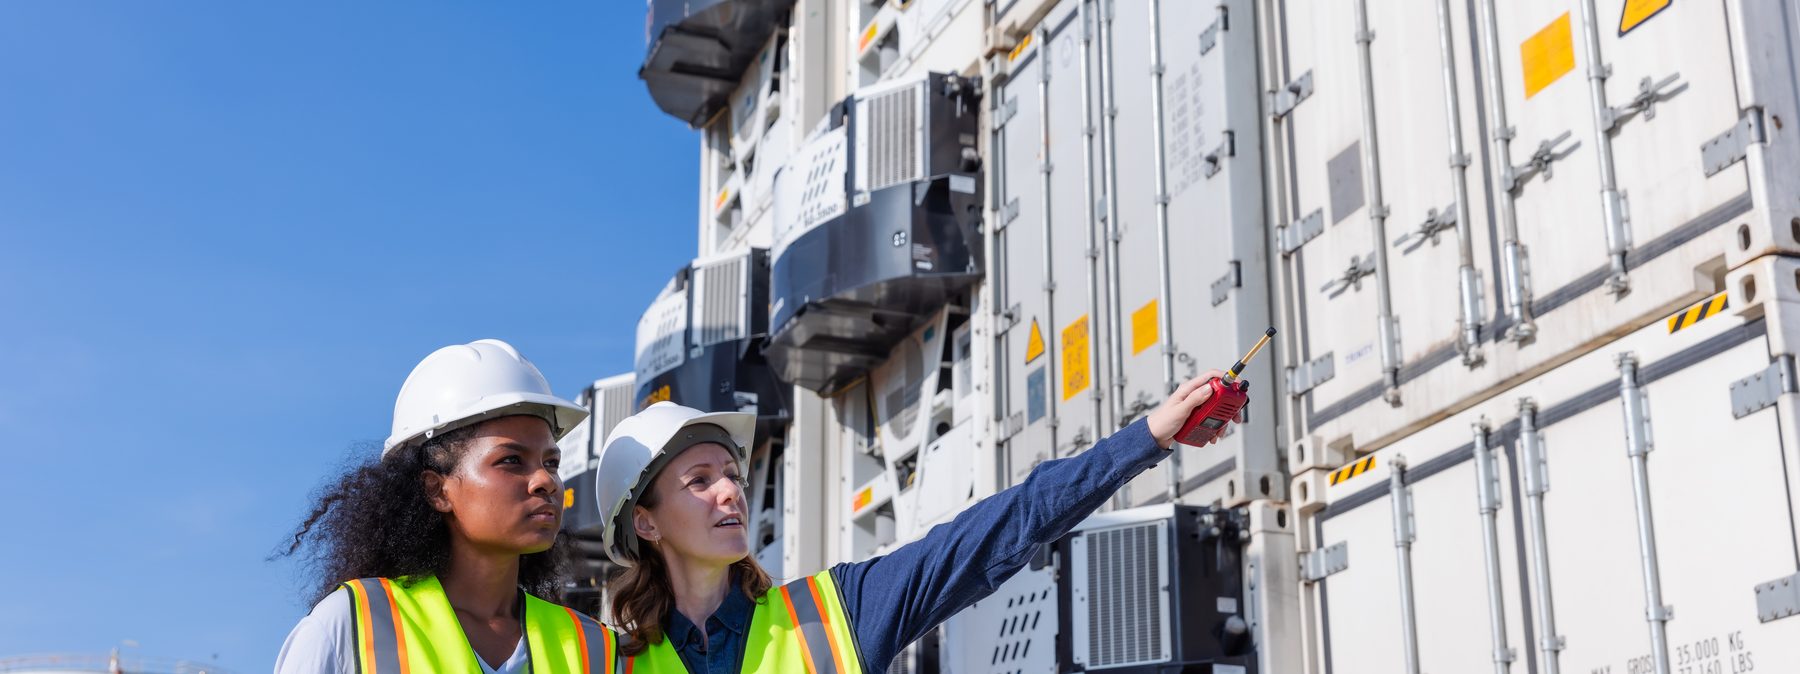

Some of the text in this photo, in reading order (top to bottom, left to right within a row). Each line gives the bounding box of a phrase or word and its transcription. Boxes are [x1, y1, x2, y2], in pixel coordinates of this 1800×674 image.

[1676, 637, 1720, 665] 35.000
[1728, 630, 1744, 652] KG
[1731, 651, 1754, 674] LBS
